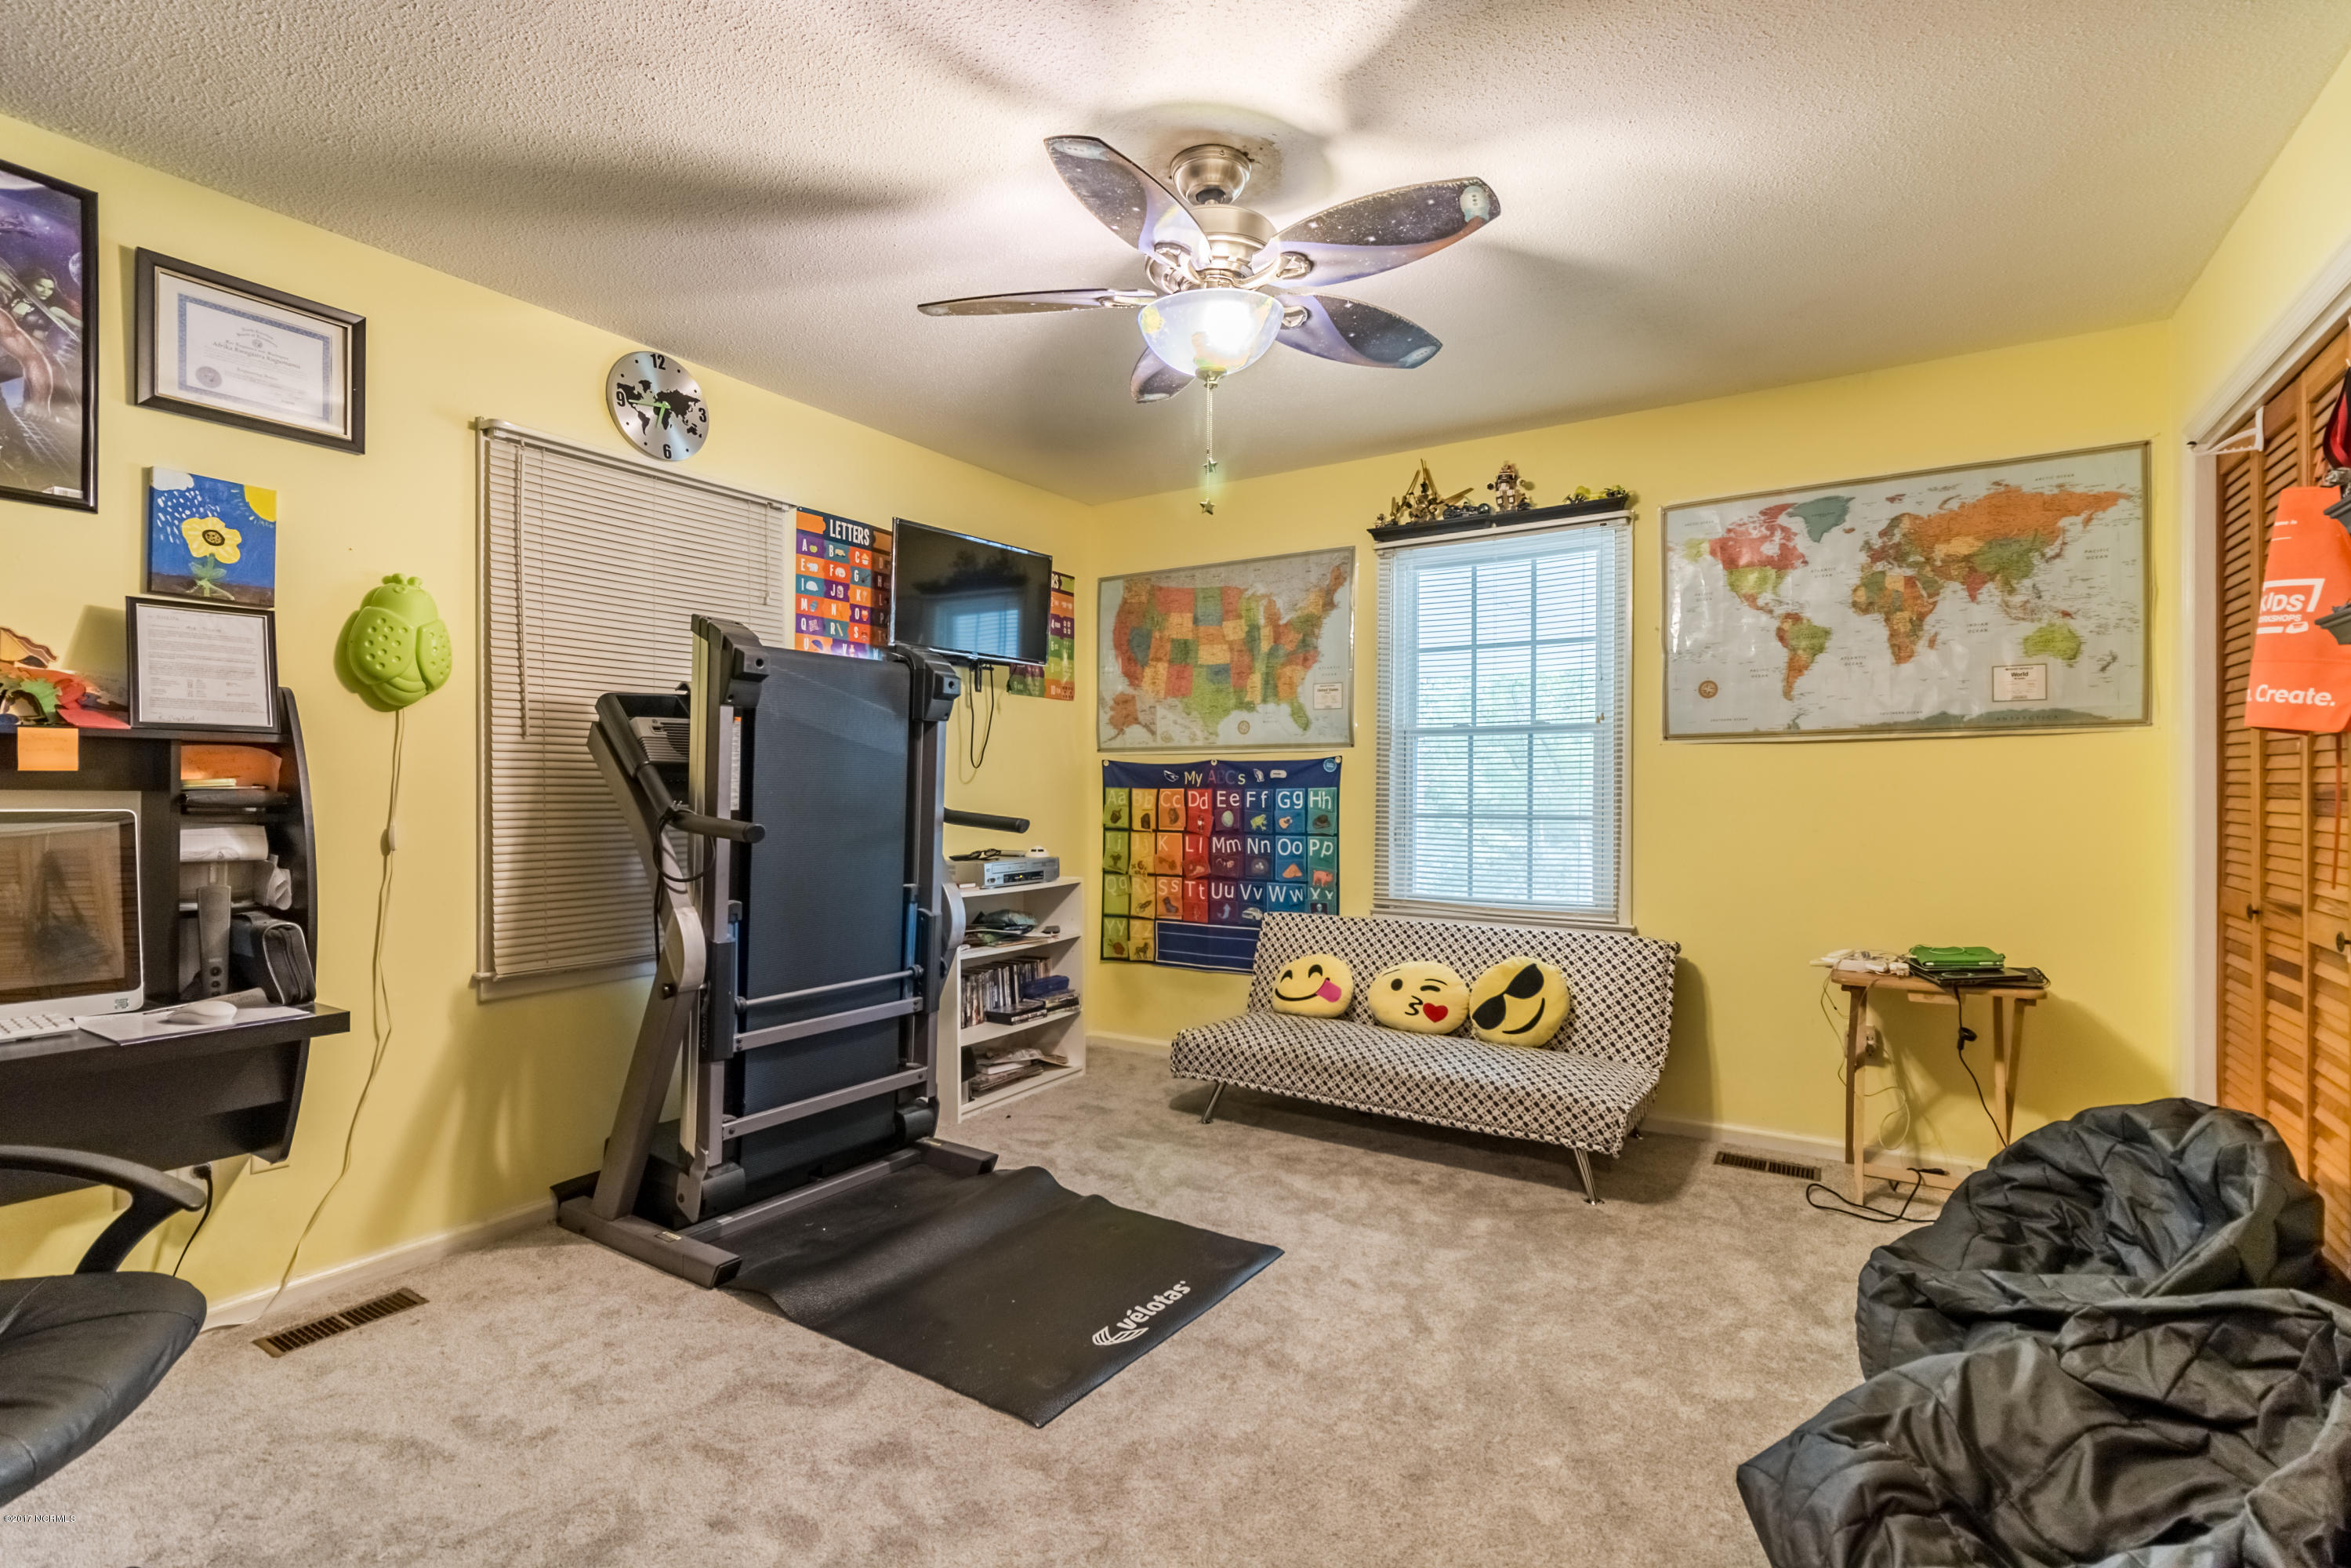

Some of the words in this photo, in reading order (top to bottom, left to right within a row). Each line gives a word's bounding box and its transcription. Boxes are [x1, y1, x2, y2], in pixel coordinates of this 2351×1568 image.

[651, 353, 666, 370] 12
[616, 390, 626, 408] 9
[698, 408, 707, 423] 3
[662, 444, 672, 459] 6
[829, 519, 870, 546] LETTERS
[802, 539, 807, 551] A
[829, 545, 834, 557] B
[854, 551, 860, 564] C
[801, 558, 805, 571] E
[829, 564, 834, 577] F
[854, 569, 859, 582] G
[878, 575, 882, 588] H
[1050, 573, 1059, 589] RS
[801, 578, 804, 591] I
[831, 584, 836, 597] J
[856, 590, 861, 601] K
[880, 594, 883, 606] L
[801, 597, 807, 612] M
[831, 604, 836, 615] N
[854, 608, 859, 619] O
[880, 612, 884, 624] P
[801, 618, 807, 630] Q
[831, 622, 836, 635] R
[854, 626, 858, 638] S
[878, 630, 882, 642] T
[1050, 619, 1054, 629] 4
[804, 637, 809, 651] U
[842, 643, 847, 657] V
[873, 648, 879, 660] W
[1050, 685, 1056, 695] 10
[2256, 684, 2335, 706] Create.
[1184, 771, 1203, 787] My
[1108, 790, 1126, 805] Aa
[1134, 791, 1154, 808] Bb
[1160, 790, 1181, 808] Cc
[1188, 791, 1209, 809] Dd
[1217, 790, 1240, 809] Ee
[1246, 790, 1268, 808] Ff
[1278, 790, 1303, 809] Gg
[1309, 790, 1331, 809] Hh
[1159, 835, 1168, 851] K
[1212, 837, 1242, 854] Mm
[1247, 837, 1271, 855] Nn
[1278, 838, 1303, 856] Oo
[1309, 839, 1333, 858] Pp
[1159, 880, 1179, 895] Ss
[1185, 881, 1206, 900] Tt
[1211, 882, 1234, 899] Uu
[1240, 884, 1263, 901] Vv
[1268, 885, 1303, 903] Ww
